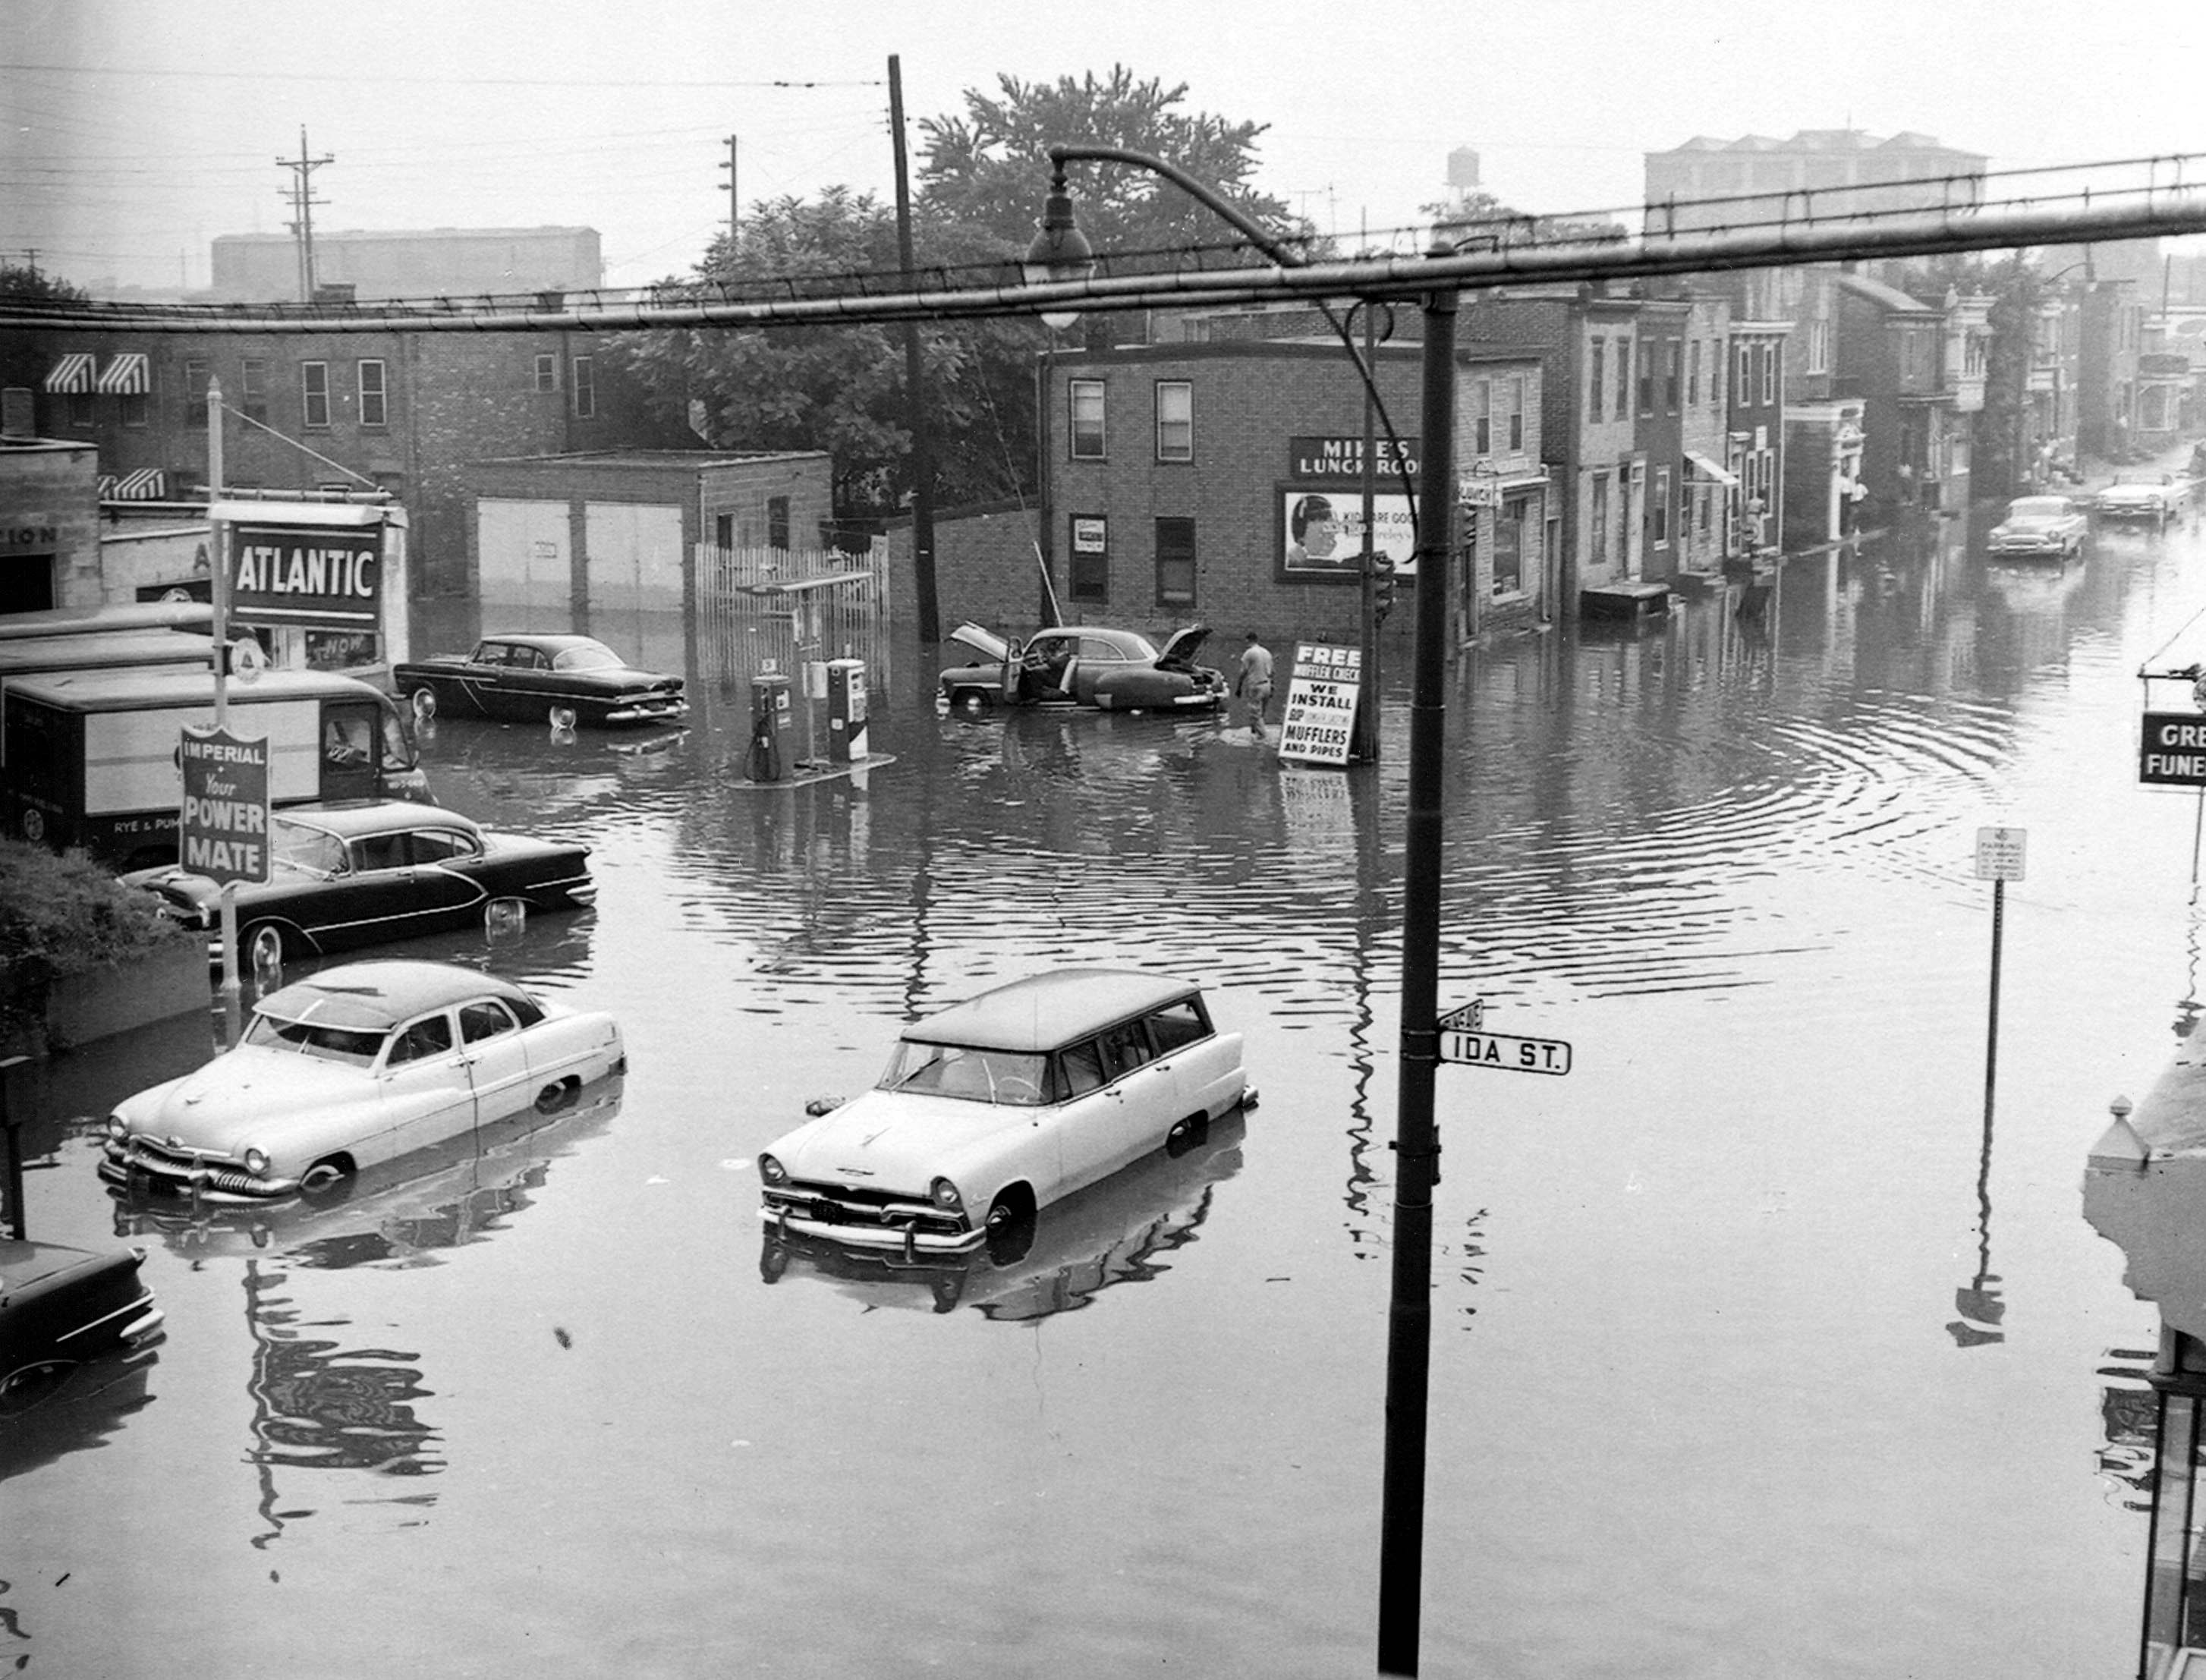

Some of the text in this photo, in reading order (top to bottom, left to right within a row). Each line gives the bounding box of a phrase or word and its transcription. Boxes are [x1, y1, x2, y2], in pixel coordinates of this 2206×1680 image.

[1376, 458, 1421, 475] ROO
[0, 526, 57, 546] ION
[236, 546, 374, 597] ATLANTIC
[1297, 645, 1362, 668] FREE
[1310, 683, 1339, 695] WE
[1291, 693, 1352, 711] INSTALL
[1284, 725, 1348, 746] MUFFLERS
[184, 741, 266, 765] IMPERIAL
[1283, 742, 1343, 758] AND PIPES
[2148, 753, 2206, 776] FUNE
[205, 771, 238, 797] Your
[184, 794, 266, 834] POWER
[114, 820, 137, 833] RYE
[187, 835, 260, 875] MATE
[1454, 1035, 1561, 1069] IDA ST.
